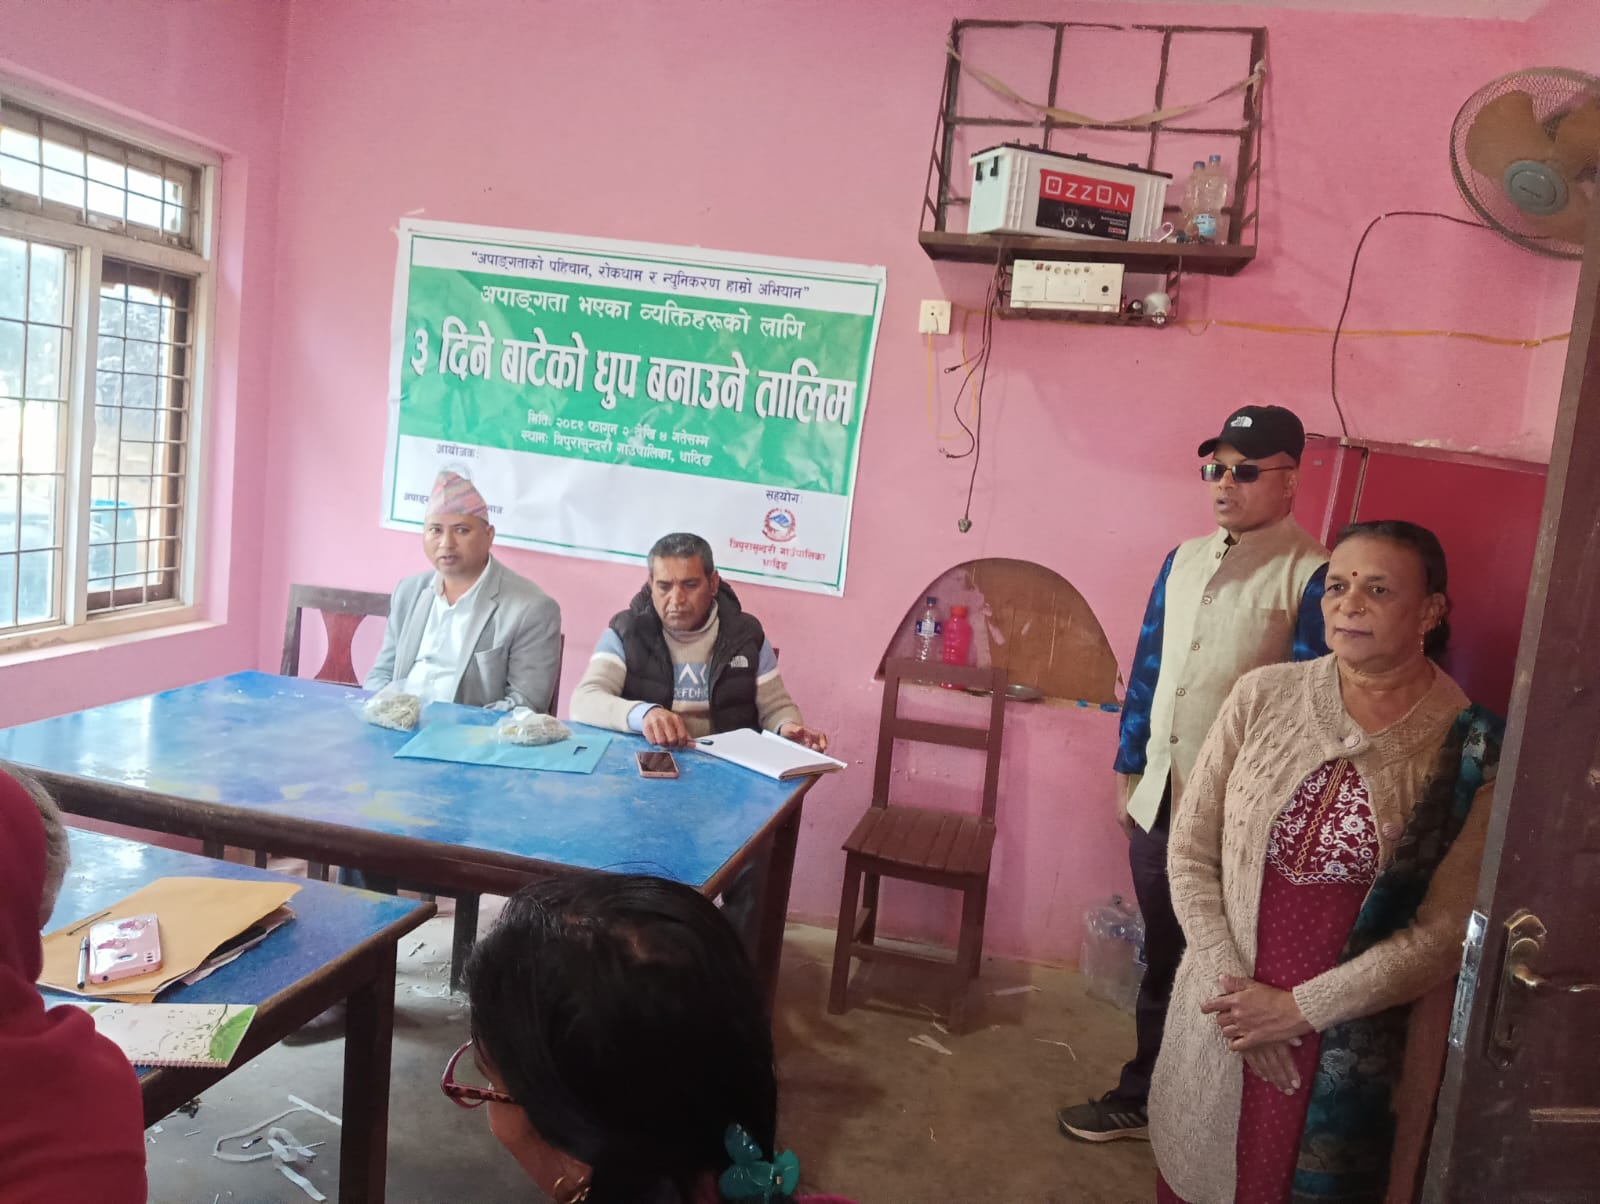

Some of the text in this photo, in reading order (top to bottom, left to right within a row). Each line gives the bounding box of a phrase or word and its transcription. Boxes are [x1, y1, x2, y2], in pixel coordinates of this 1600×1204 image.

[1044, 175, 1130, 208] OZZON
[549, 258, 593, 279] पहिचान,
[598, 262, 643, 281] रोकथाम
[649, 271, 658, 283] र
[663, 270, 721, 291] न्युनिकरण
[726, 277, 752, 293] हाम्रो
[480, 285, 806, 340] अपाङ्गता भएका व्यक्तिहरूको लागि
[411, 328, 429, 376] ३
[439, 315, 495, 382] दिने
[500, 326, 588, 392] बाटेको
[646, 351, 750, 413] बनाउने
[755, 356, 857, 426] तालिम
